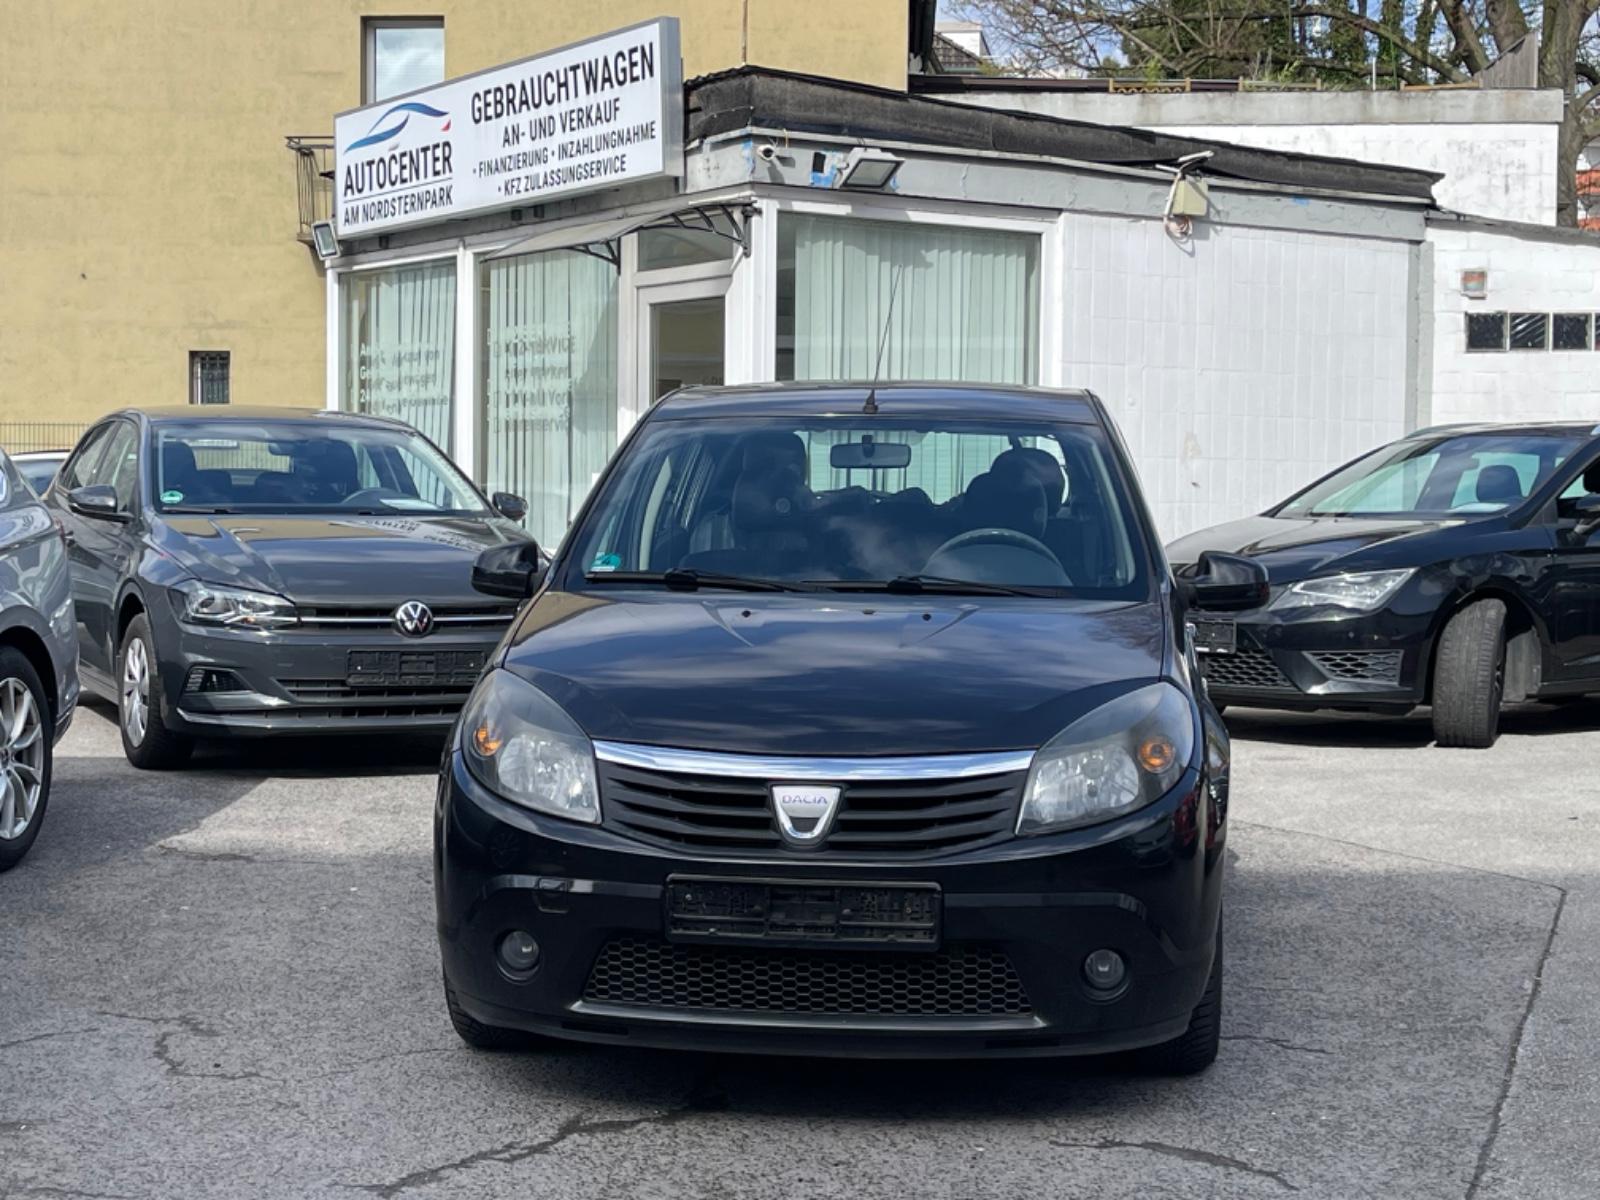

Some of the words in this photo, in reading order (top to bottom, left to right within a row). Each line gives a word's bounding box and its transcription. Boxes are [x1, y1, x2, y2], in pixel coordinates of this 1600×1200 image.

[471, 42, 654, 124] GEBRAUCHTWAGEN
[503, 123, 526, 148] AN-
[529, 115, 556, 141] UND
[560, 97, 621, 134] VERKAUF
[344, 141, 453, 198] AUTOCENTER
[478, 147, 548, 178] FINANZIERUNG
[558, 121, 656, 160] INZAHLUNGNAHME
[504, 177, 522, 196] KFZ
[524, 154, 627, 192] ZULASSUNGSERVICE
[343, 205, 359, 227] AM
[362, 184, 453, 222] NORDSTERNPARK
[782, 795, 828, 805] DACIA
